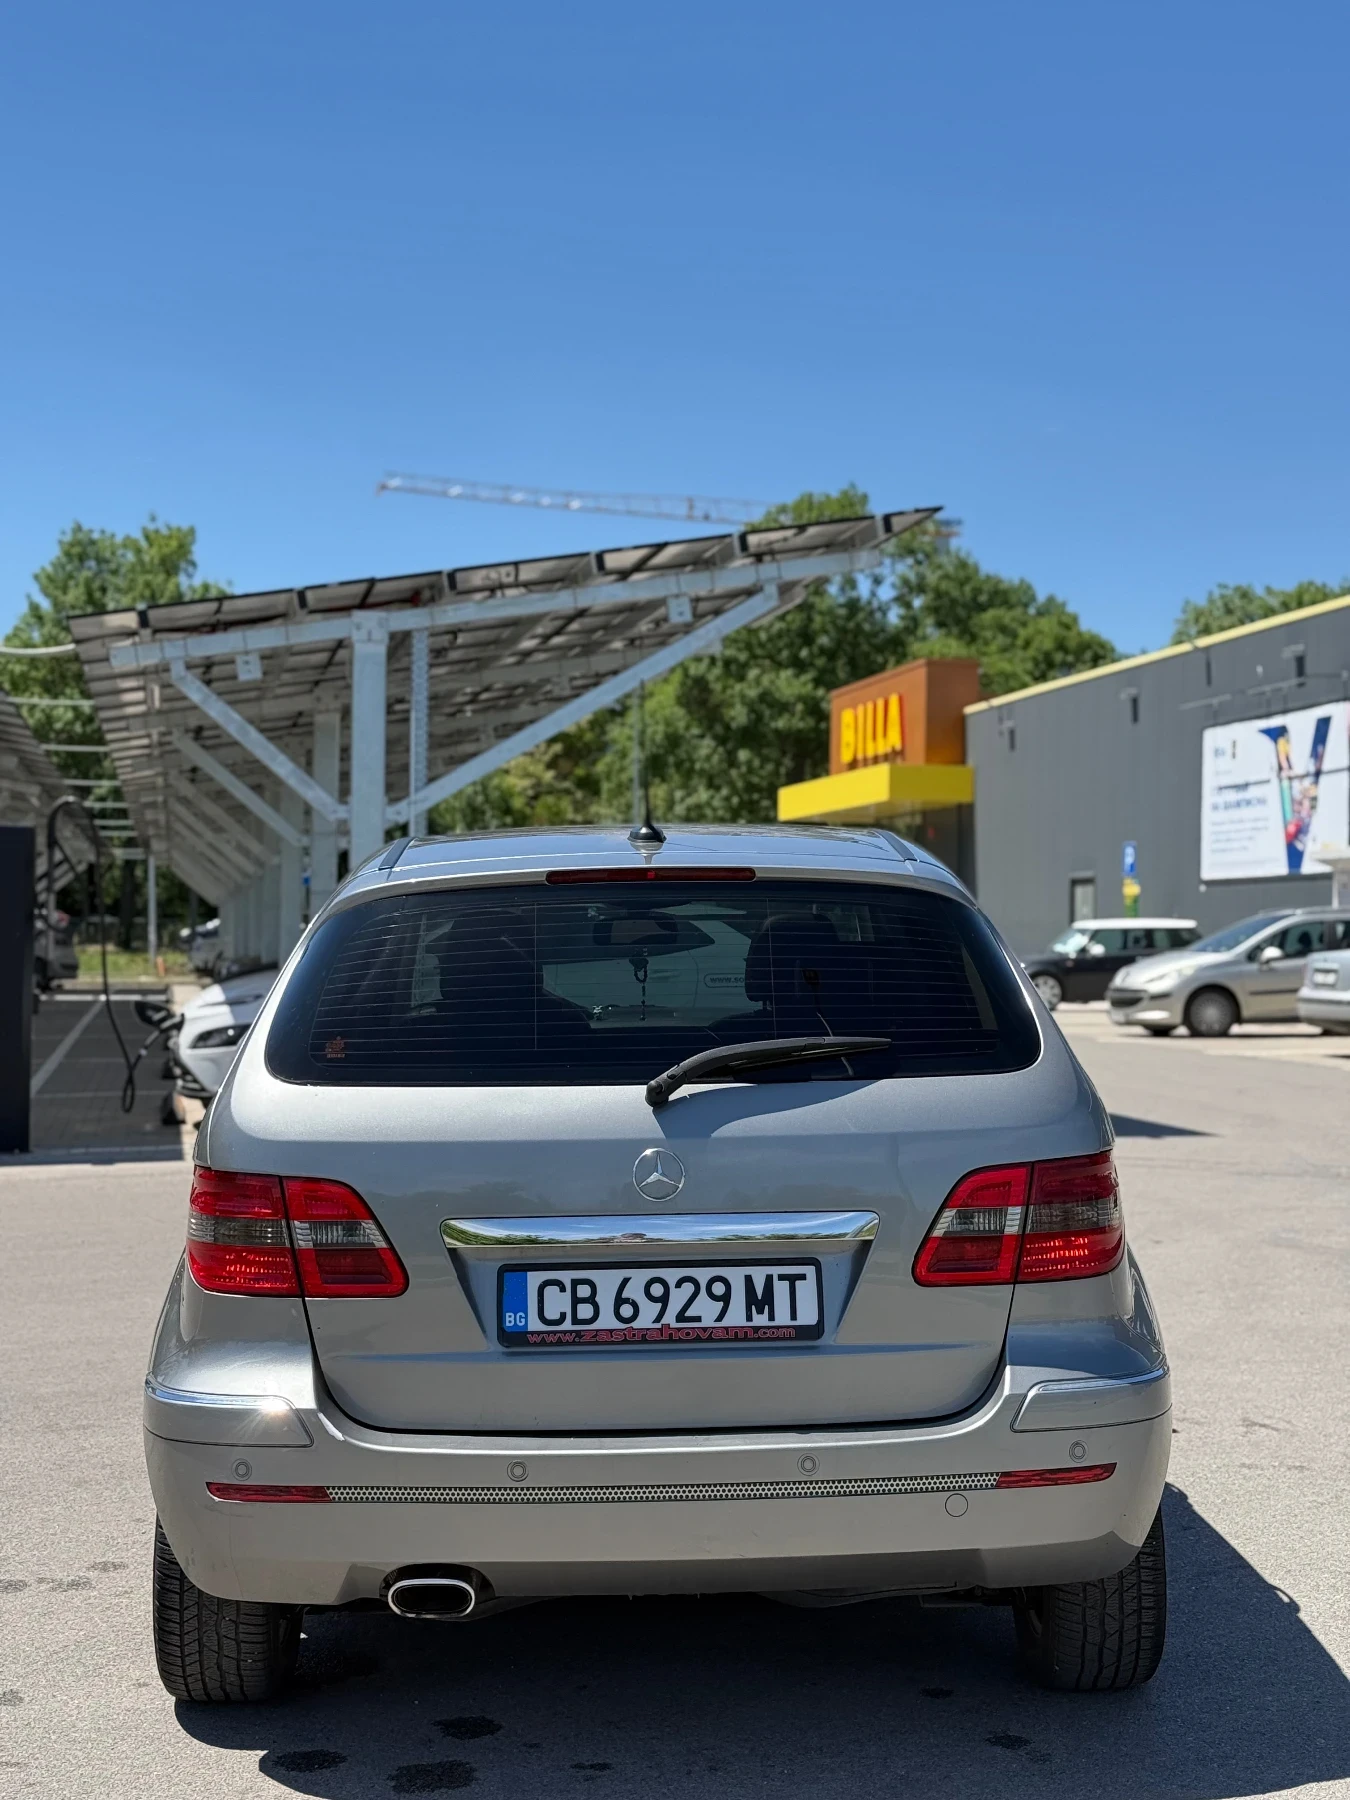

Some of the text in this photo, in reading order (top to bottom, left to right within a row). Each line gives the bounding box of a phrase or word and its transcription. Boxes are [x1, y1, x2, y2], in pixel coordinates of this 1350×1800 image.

[841, 692, 902, 763] BILLA
[709, 976, 745, 984] www.so
[537, 1273, 807, 1326] CB 6929 MT
[505, 1312, 526, 1327] BG
[527, 1323, 796, 1344] www.zastrahovam.com
